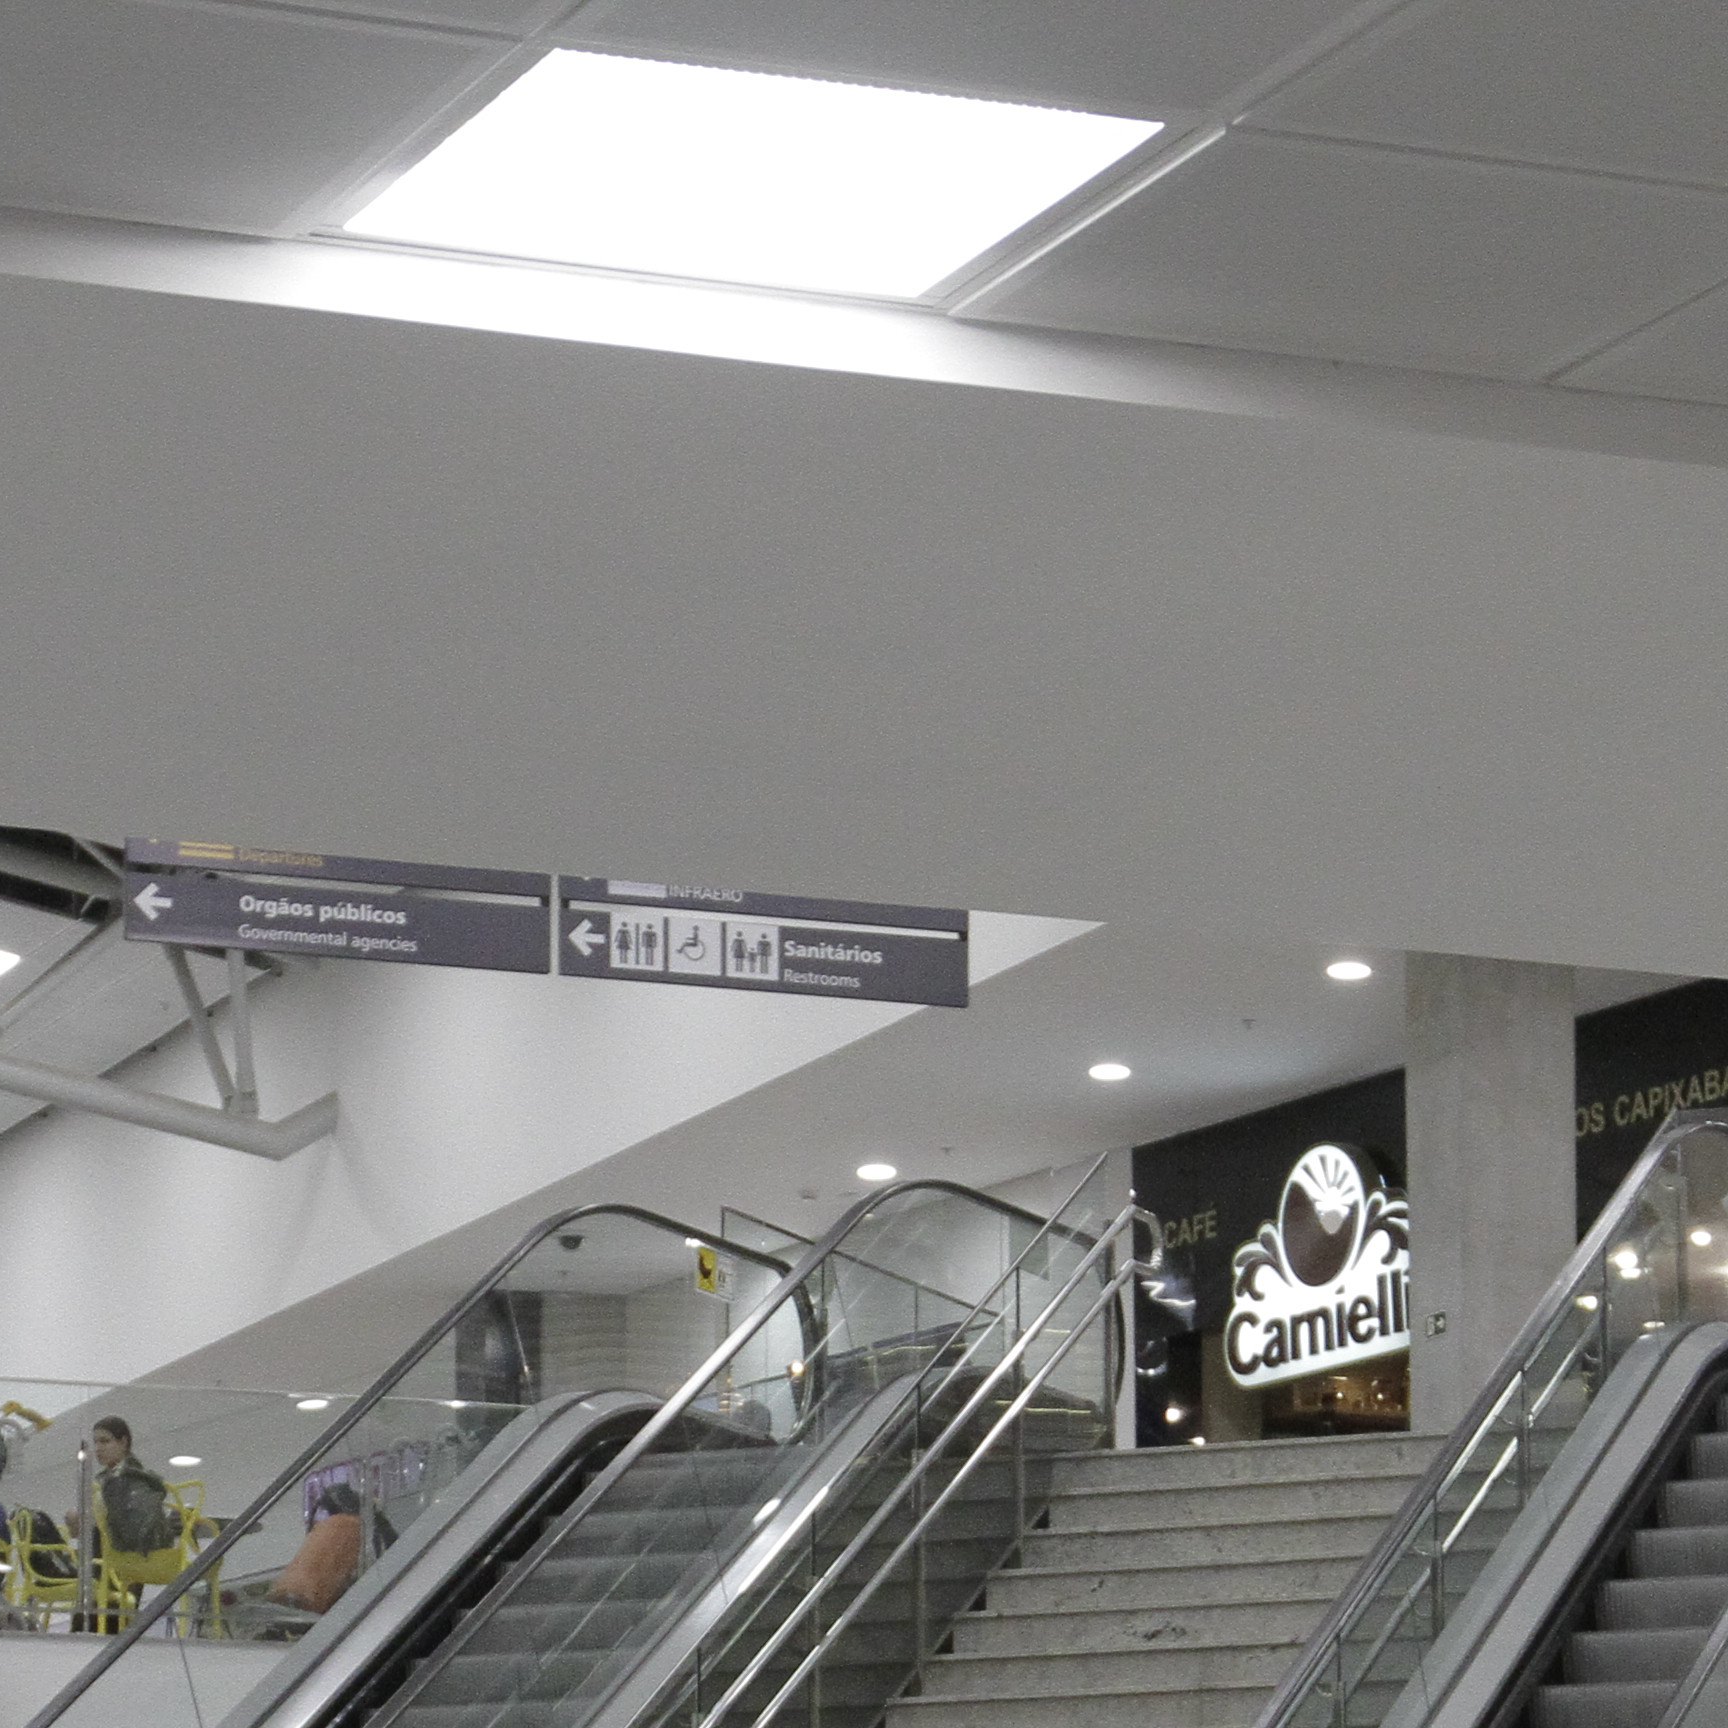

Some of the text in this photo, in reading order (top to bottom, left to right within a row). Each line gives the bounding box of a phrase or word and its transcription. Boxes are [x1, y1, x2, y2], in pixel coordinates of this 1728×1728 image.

[319, 899, 407, 925] públicos
[238, 923, 418, 954] Governmental agencies
[784, 939, 884, 965] Sanitários
[784, 967, 861, 988] Restrooms
[1163, 1203, 1218, 1250] CAFÉ
